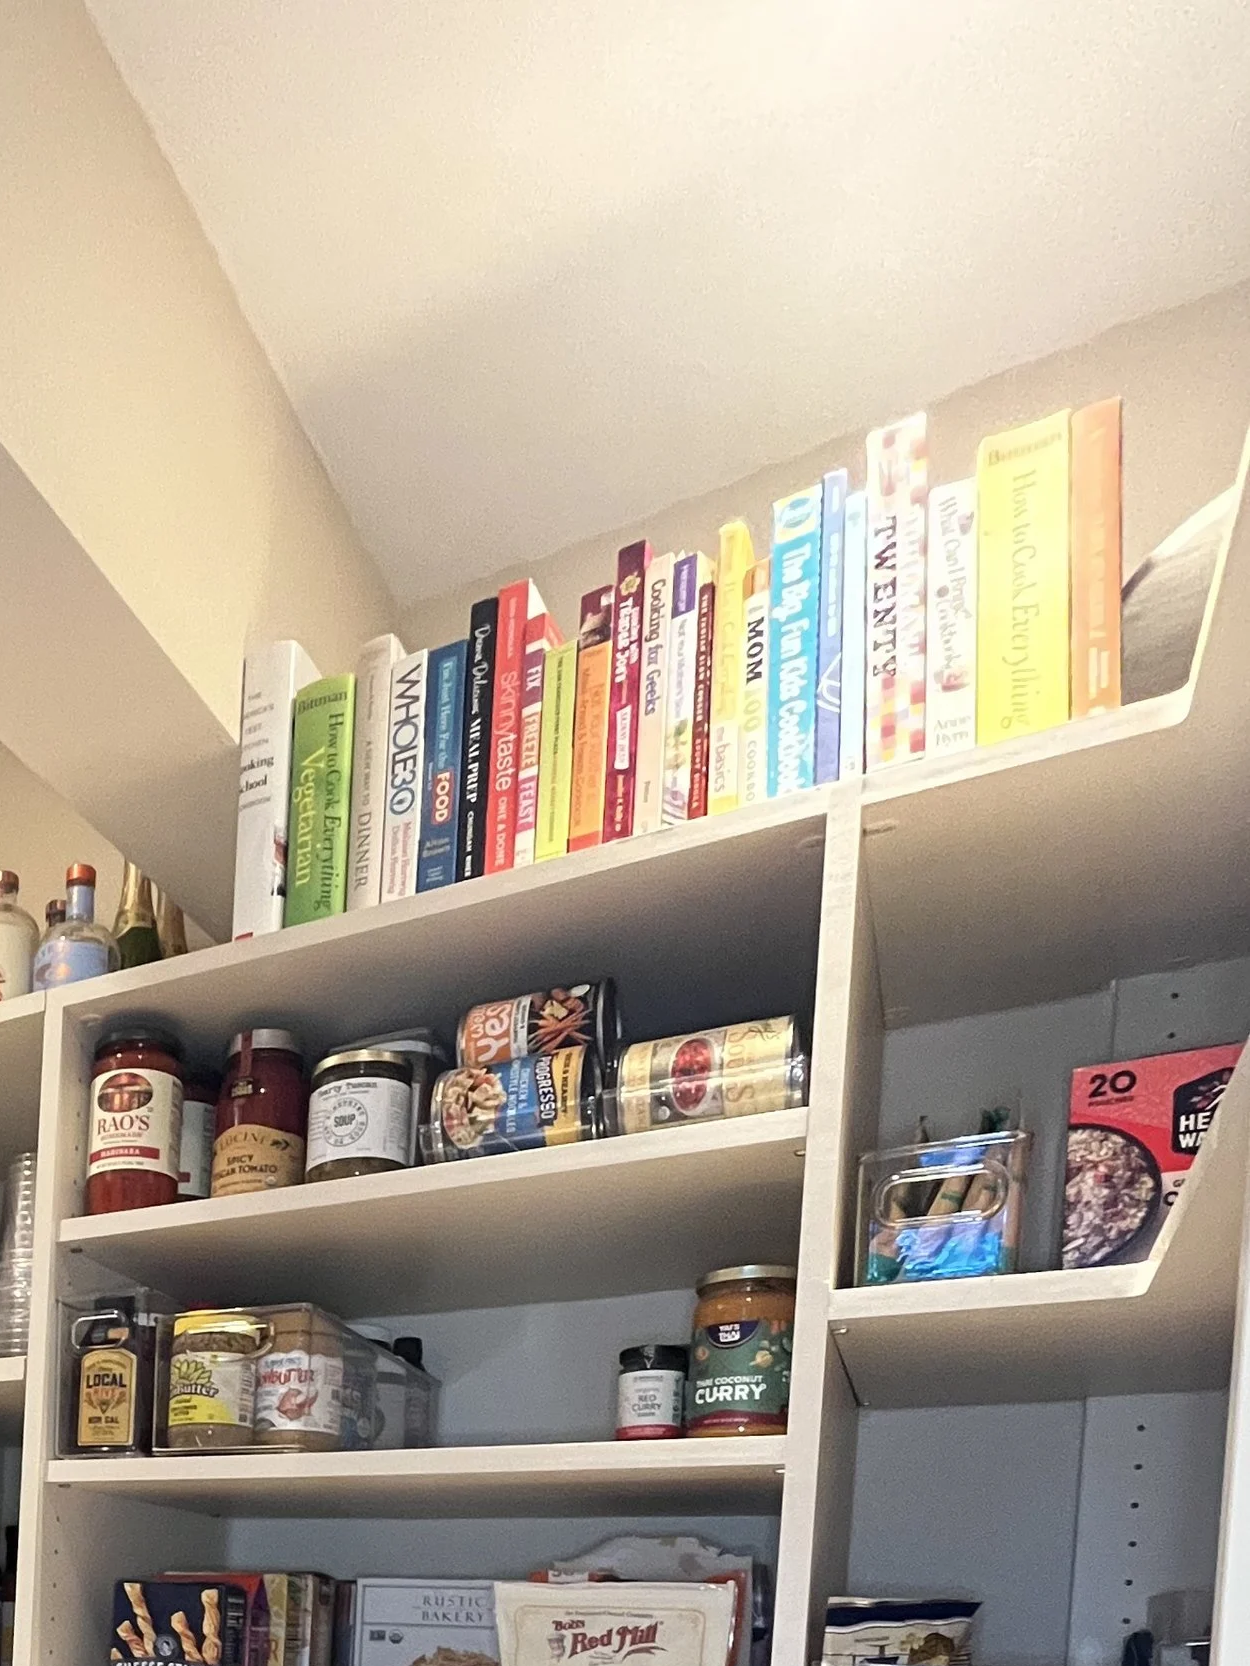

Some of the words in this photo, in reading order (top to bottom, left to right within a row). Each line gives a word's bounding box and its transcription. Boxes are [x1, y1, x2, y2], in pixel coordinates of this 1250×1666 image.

[1013, 469, 1037, 520] How
[1013, 523, 1031, 545] to
[781, 543, 812, 583] The
[1011, 545, 1037, 601] Cook
[645, 580, 666, 642] Cooking
[873, 516, 897, 678] TWENTY
[746, 617, 765, 685] MOM
[779, 622, 809, 655] Fun
[526, 666, 542, 688] FIX
[780, 656, 807, 701] Kids
[1000, 604, 1041, 730] Everything
[645, 670, 662, 716] Geeks
[327, 713, 344, 749] How
[389, 664, 421, 815] WHOLE30
[468, 718, 481, 762] MEAL
[494, 671, 521, 791] skinnytaste
[521, 715, 538, 768] FREEZE
[326, 753, 340, 768] to
[715, 744, 730, 793] basics
[323, 769, 342, 810] Cook
[435, 772, 450, 822] FOOD
[466, 763, 479, 804] PREP
[293, 746, 325, 888] Vegetarian
[496, 796, 507, 821] ONE
[517, 782, 535, 826] FEAST
[314, 814, 341, 911] Everything
[354, 812, 372, 891] DINNER
[495, 832, 506, 866] DONE
[519, 1068, 530, 1100] CHICKEN
[535, 1056, 555, 1119] PROGRESSO
[1089, 1070, 1137, 1099] 20
[98, 1114, 150, 1137] RAO'S
[334, 1114, 356, 1127] SOUP
[226, 1154, 254, 1166] SPICY
[239, 1165, 277, 1174] TOMATO
[86, 1372, 127, 1389] LOCAL
[695, 1384, 764, 1405] CURRY
[714, 1376, 763, 1385] COCONUT
[631, 1403, 662, 1412] CURRY
[421, 1610, 484, 1623] BAKERY
[422, 1593, 484, 1609] RUSTIC
[552, 1619, 586, 1632] Bob's
[568, 1630, 612, 1658] Red
[613, 1621, 660, 1653] Mill
